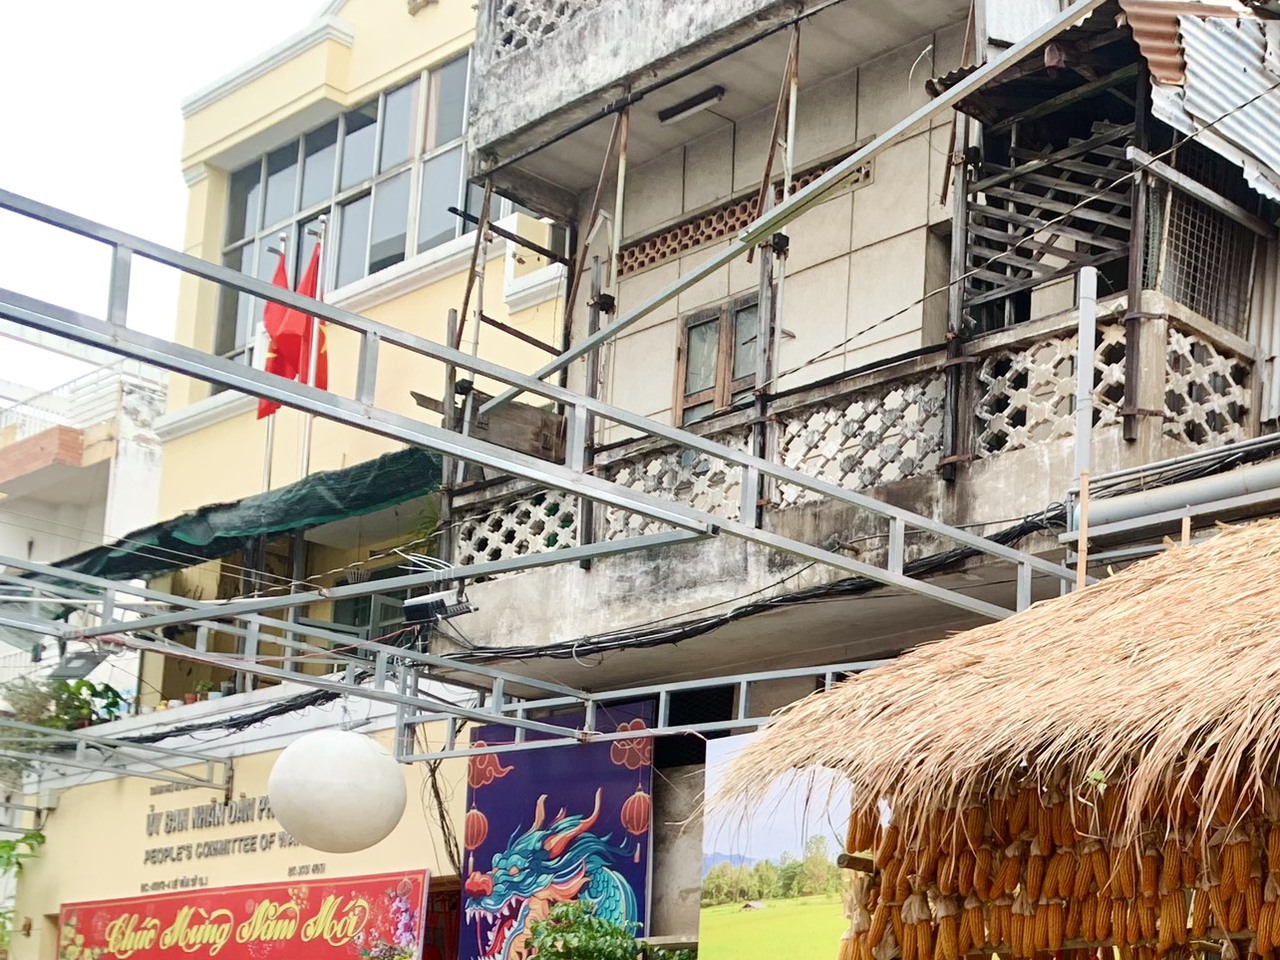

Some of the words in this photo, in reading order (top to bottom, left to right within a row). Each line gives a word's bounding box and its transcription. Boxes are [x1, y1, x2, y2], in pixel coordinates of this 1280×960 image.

[164, 808, 190, 835] BAN
[192, 797, 226, 830] NHÂN
[228, 792, 255, 823] DÂN
[144, 843, 193, 865] PEOPLE'S
[195, 833, 257, 860] COMMITTEE
[259, 832, 276, 850] OF
[105, 913, 161, 959] Chúc
[159, 904, 234, 956] Mừng
[236, 899, 300, 943] Năm
[301, 894, 369, 946] Mới
